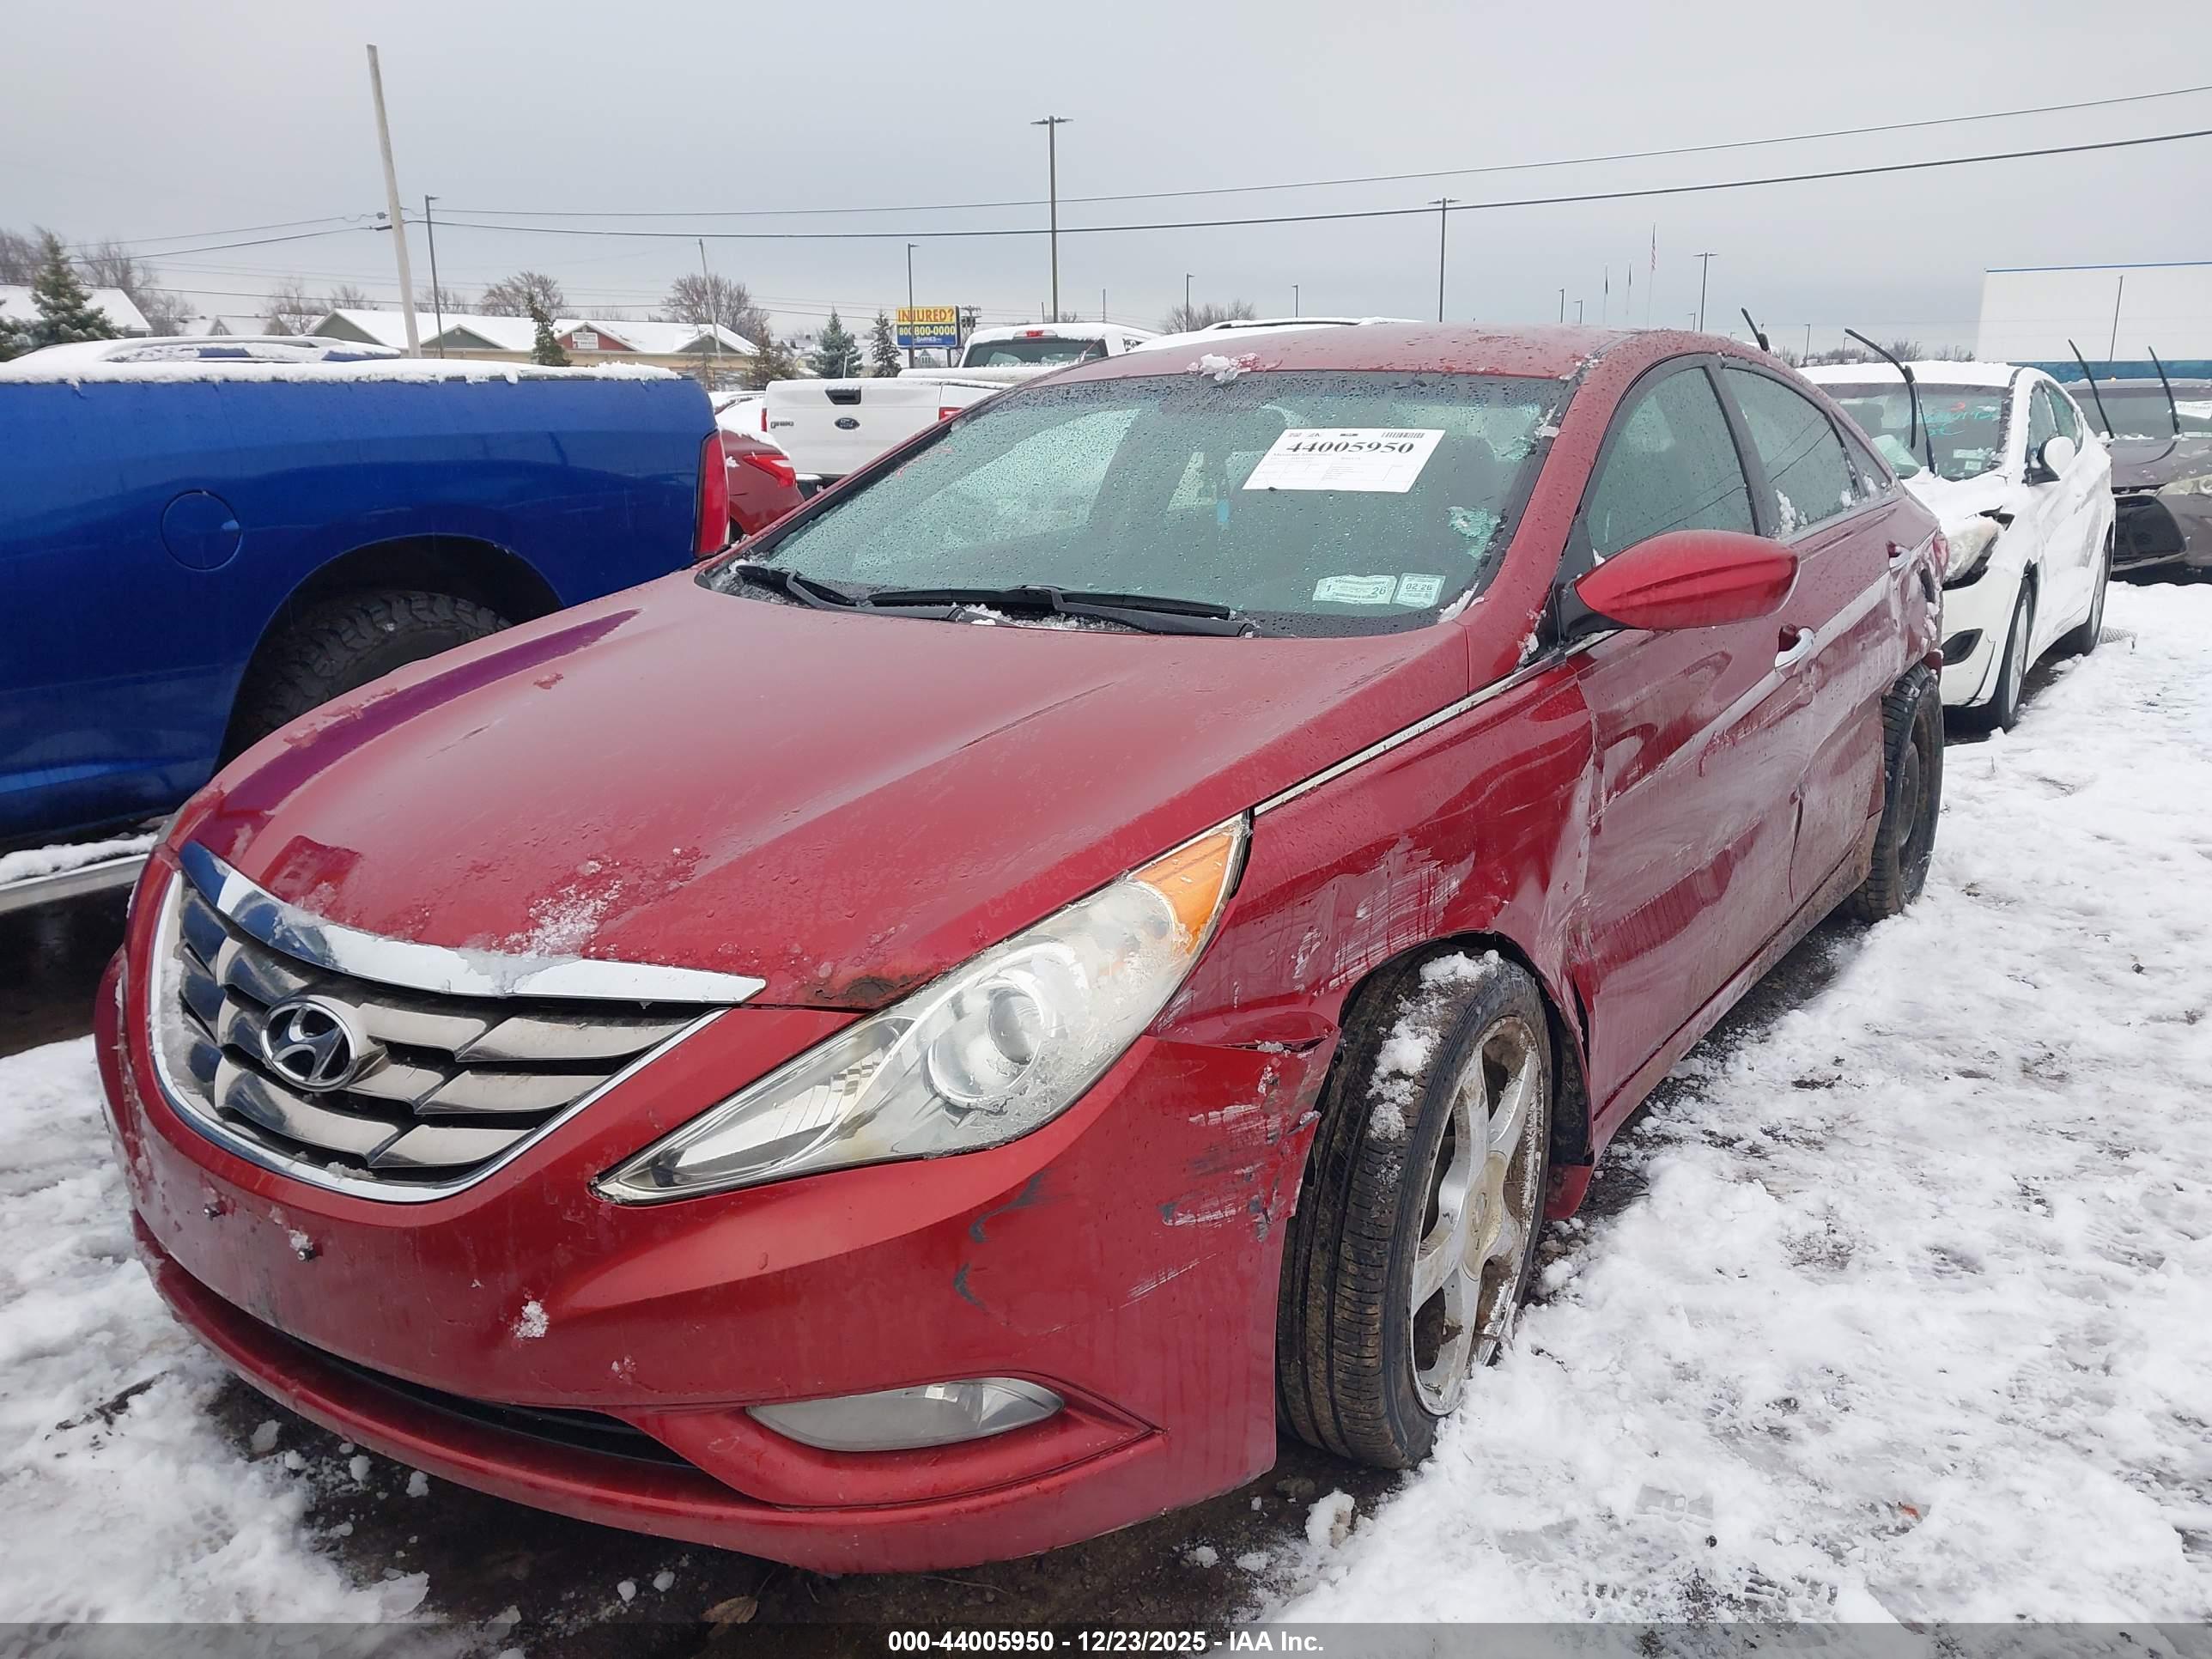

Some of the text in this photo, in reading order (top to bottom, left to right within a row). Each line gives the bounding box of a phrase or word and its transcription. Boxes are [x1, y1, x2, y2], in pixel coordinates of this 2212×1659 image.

[898, 308, 954, 322] INJURED?
[915, 325, 956, 336] 800-0000
[1285, 441, 1415, 453] 44005950
